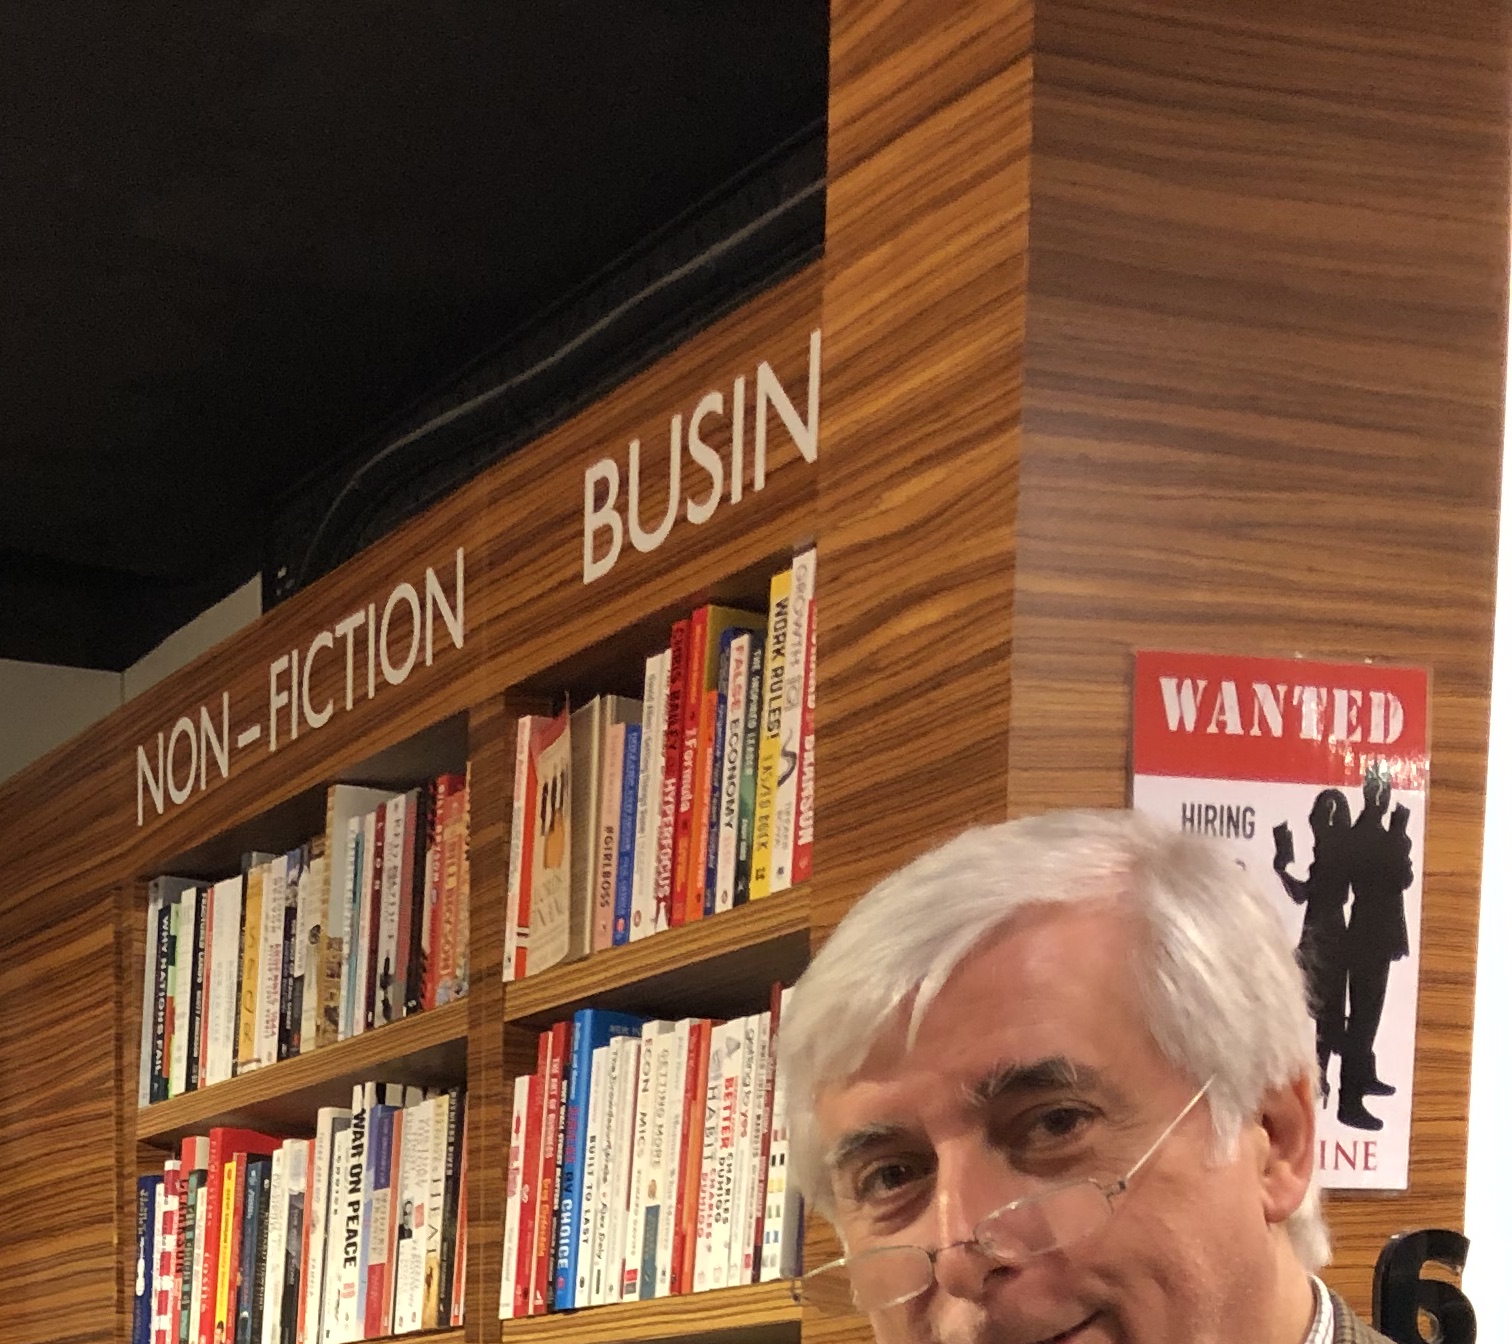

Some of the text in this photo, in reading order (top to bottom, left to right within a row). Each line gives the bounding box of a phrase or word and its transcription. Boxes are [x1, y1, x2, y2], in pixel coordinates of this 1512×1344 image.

[767, 596, 789, 740] WORK RULES!
[724, 645, 745, 828] FALSE ECONOMY
[1158, 676, 1405, 746] WANTED
[657, 778, 677, 898] HYPERFOCUS
[1180, 800, 1255, 839] HIRING
[344, 1109, 365, 1269] WAR ON PEACE
[587, 1135, 596, 1177] BUILT
[722, 1153, 733, 1224] CHARLES
[585, 1184, 593, 1202] TO
[558, 1199, 577, 1268] CHOICE
